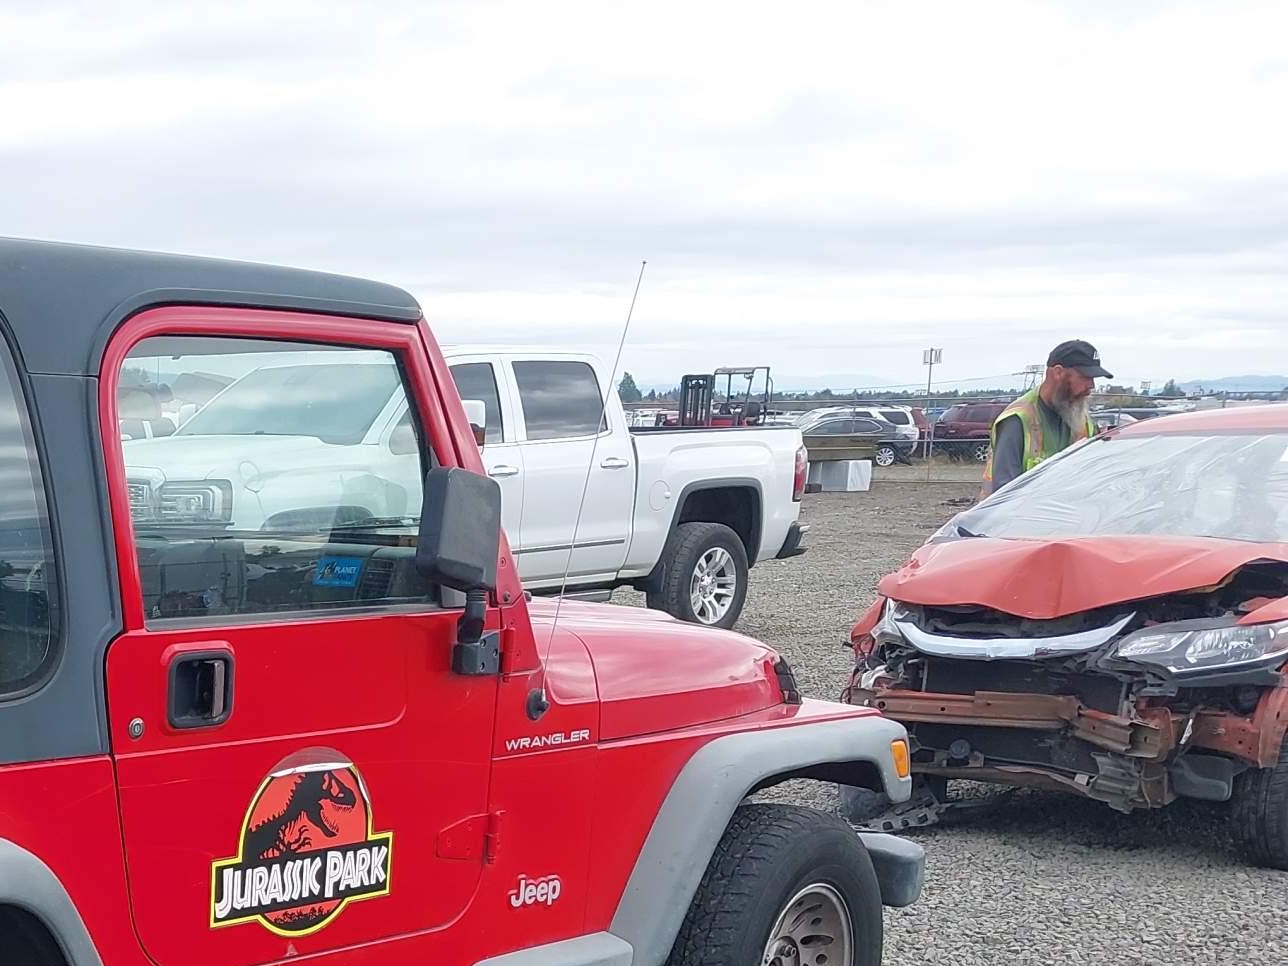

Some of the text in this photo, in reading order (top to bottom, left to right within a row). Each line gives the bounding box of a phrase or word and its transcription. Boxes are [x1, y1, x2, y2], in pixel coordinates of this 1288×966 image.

[505, 729, 590, 751] WRANGLER
[214, 845, 388, 918] JURASSIC PARK
[510, 878, 561, 907] Jeep
